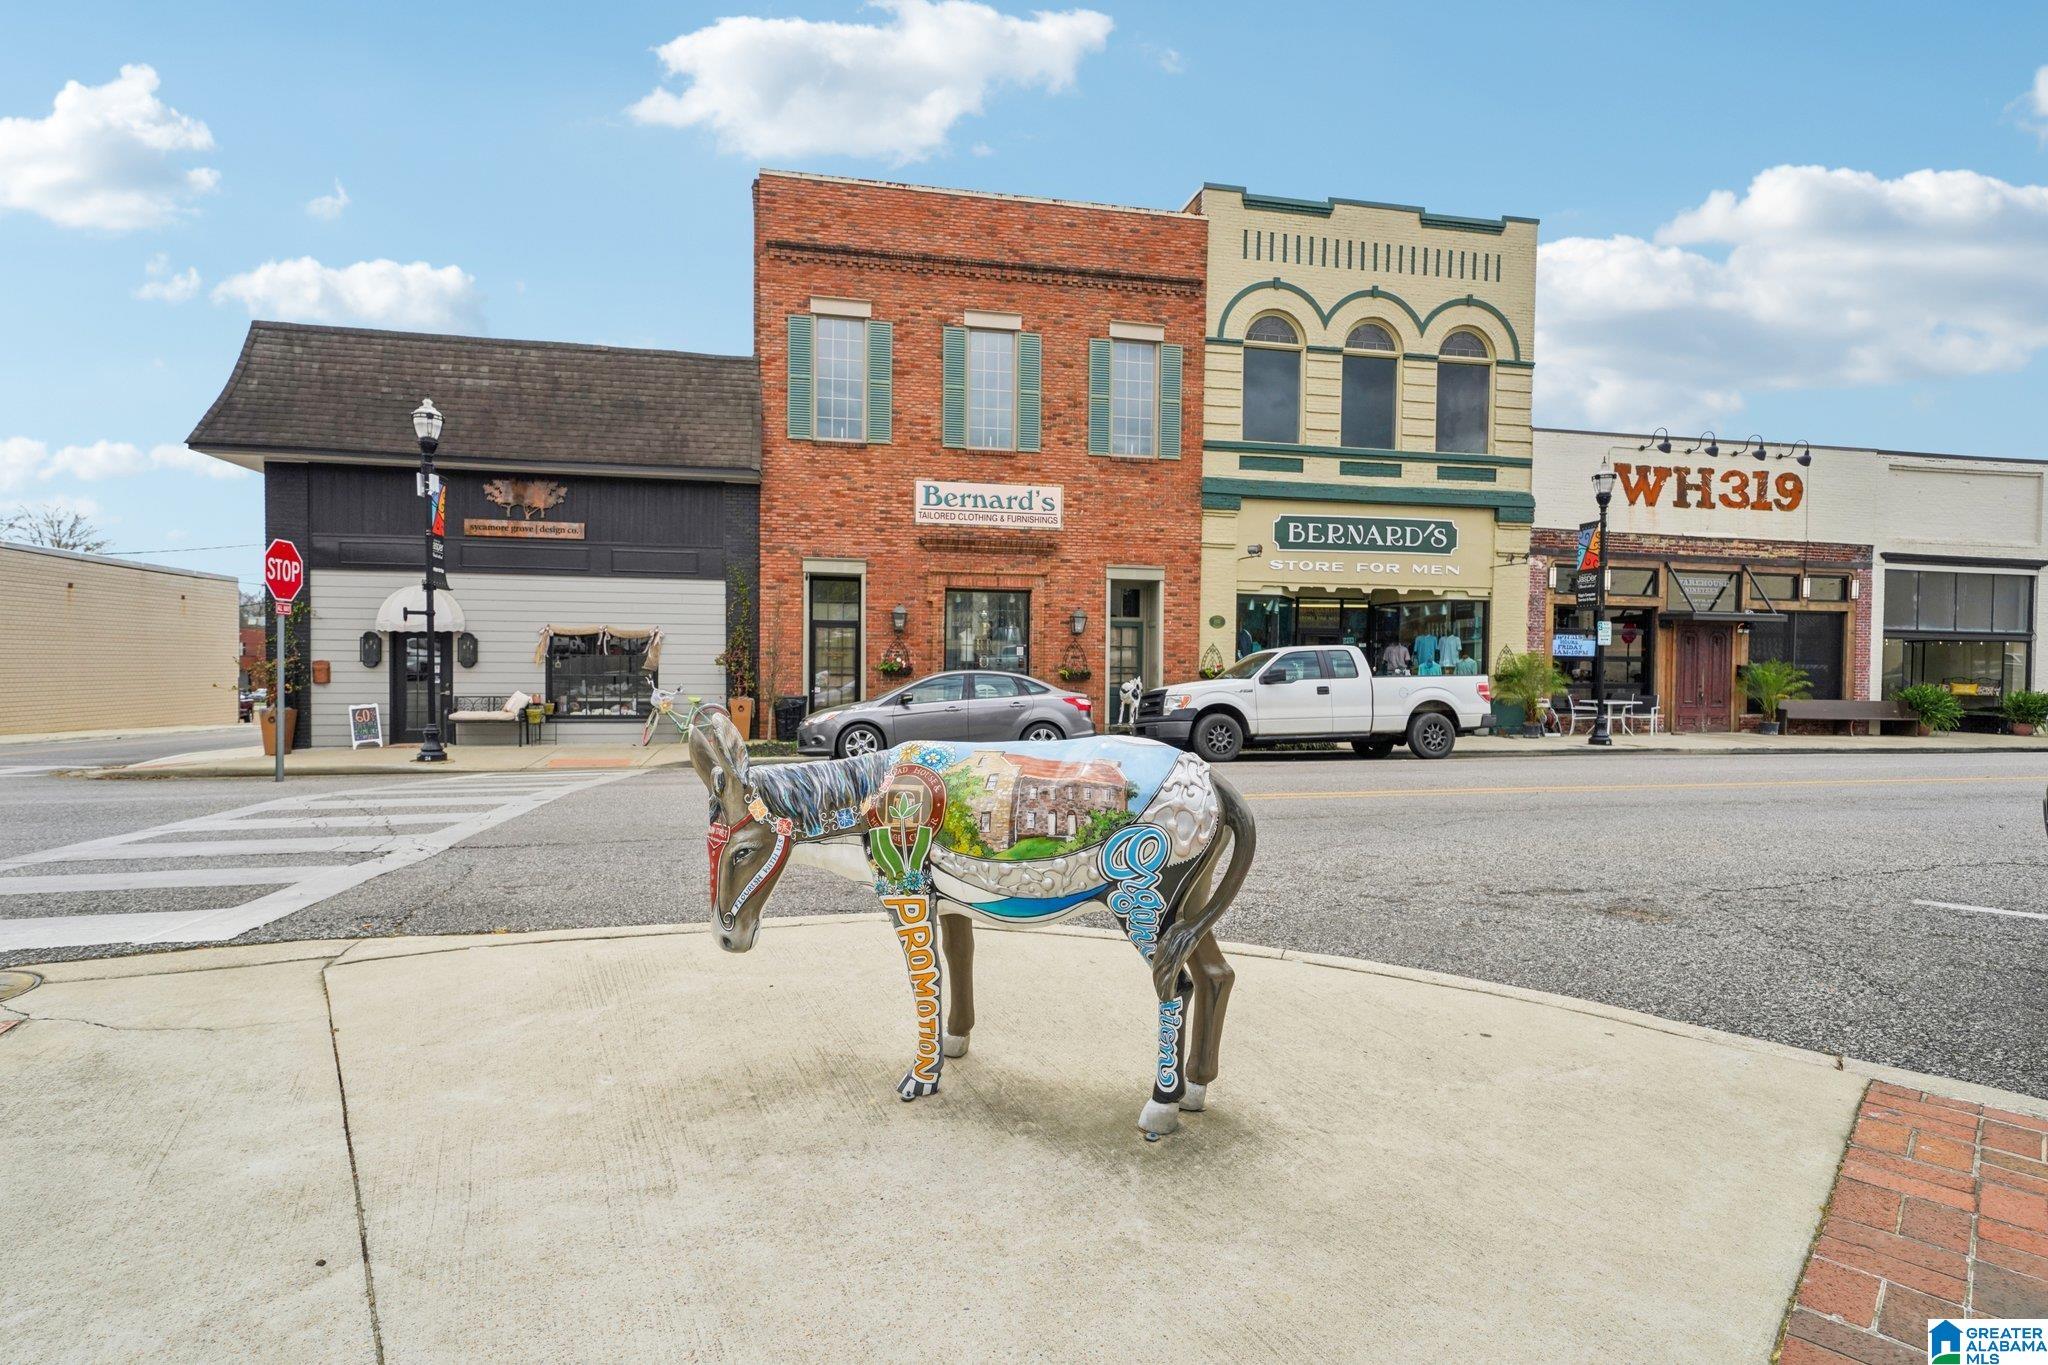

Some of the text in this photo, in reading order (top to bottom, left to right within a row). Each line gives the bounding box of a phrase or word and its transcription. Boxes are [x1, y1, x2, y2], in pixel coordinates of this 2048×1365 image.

[922, 484, 1056, 512] Bernard's
[1613, 462, 1804, 512] WH319
[470, 523, 509, 532] sycamore
[511, 525, 534, 533] grove
[539, 525, 566, 535] design
[918, 511, 956, 521] TAILORED
[958, 512, 998, 522] CLOTHING
[1006, 515, 1058, 525] FURNISHINGS
[1287, 521, 1447, 548] BERNARD'S
[266, 557, 300, 583] STOP
[1269, 559, 1460, 575] STORE FOR MEN
[913, 766, 939, 785] HOUSE
[734, 838, 785, 910] FLOURISH WITH US
[883, 897, 938, 1081] PROMOTION
